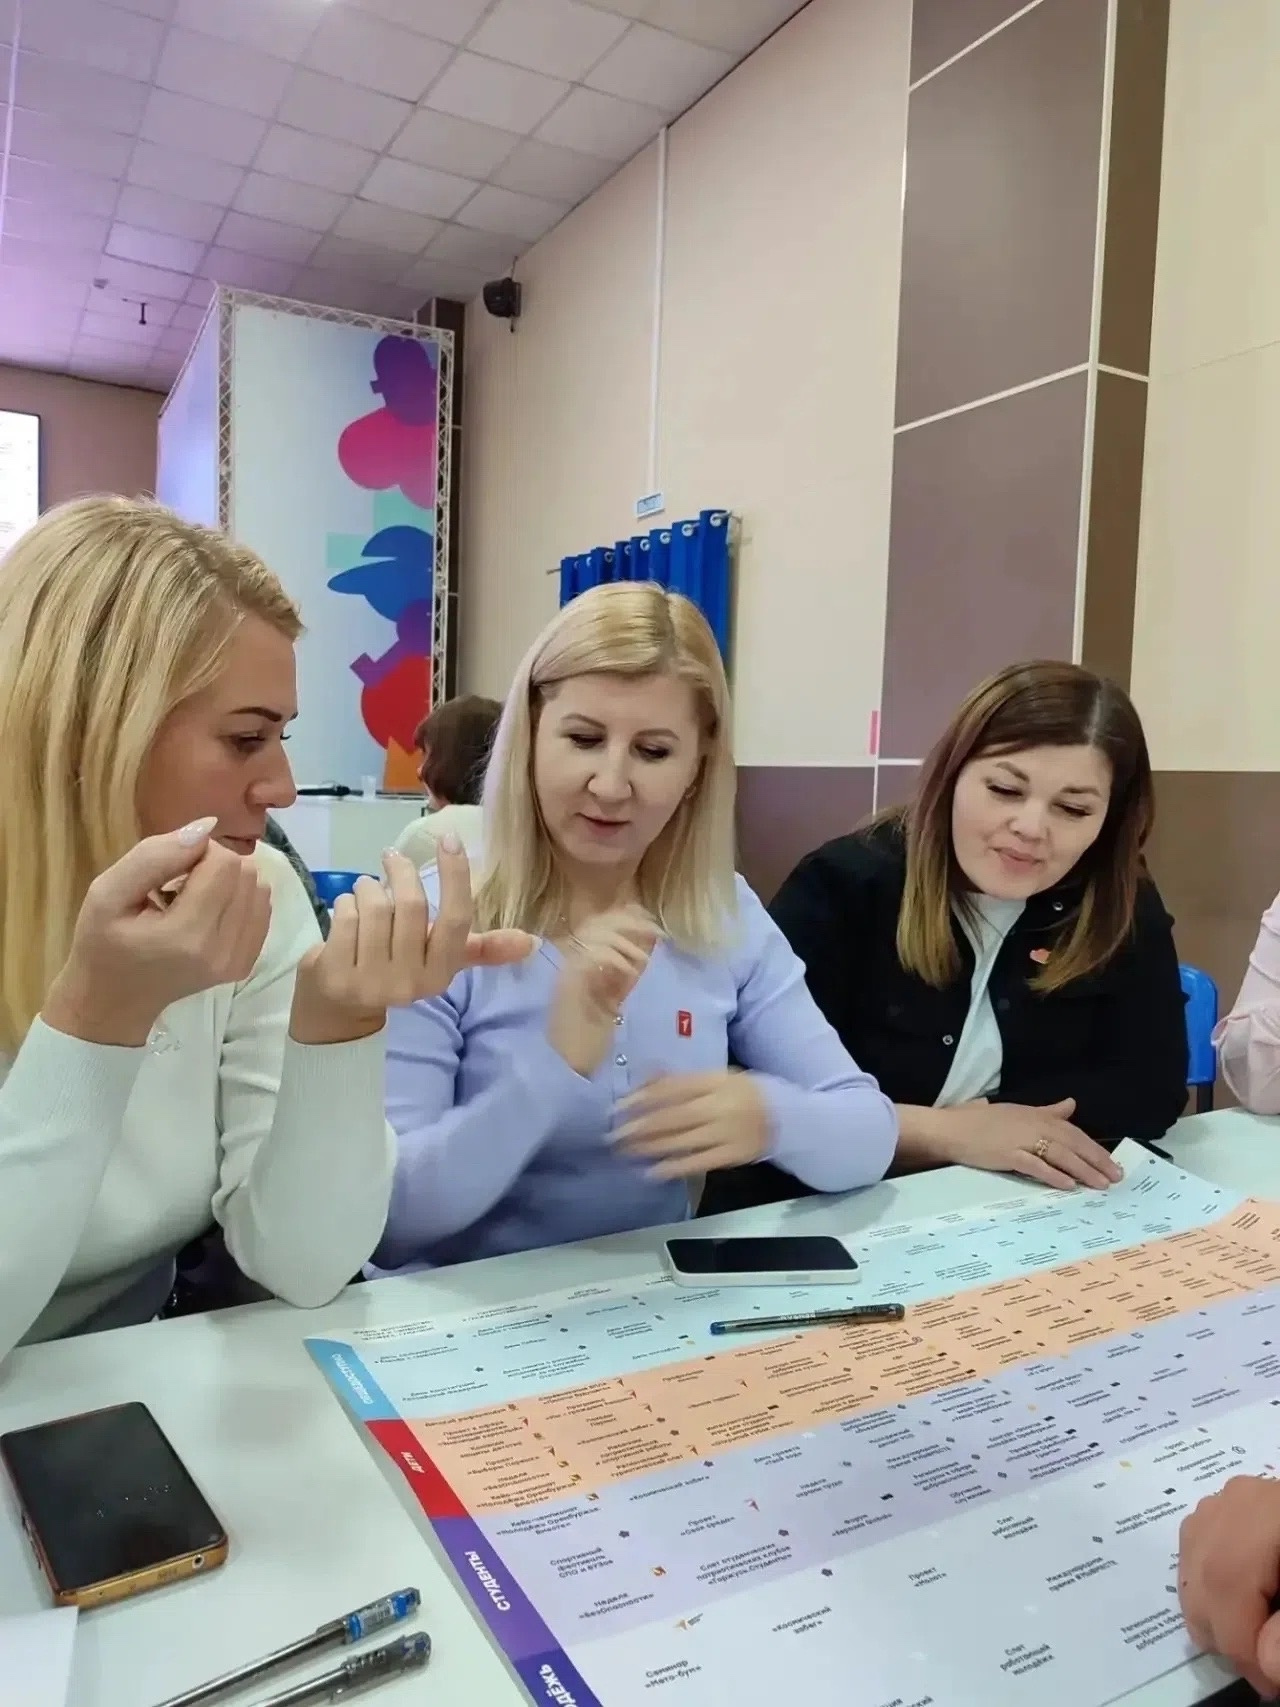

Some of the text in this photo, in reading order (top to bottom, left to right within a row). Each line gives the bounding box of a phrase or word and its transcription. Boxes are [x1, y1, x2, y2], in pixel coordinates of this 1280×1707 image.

[401, 1451, 425, 1474] ДЕТИ
[464, 1550, 511, 1612] СТУДЕНТЫ
[907, 1567, 938, 1580] Проект
[644, 1659, 689, 1679] Семинар
